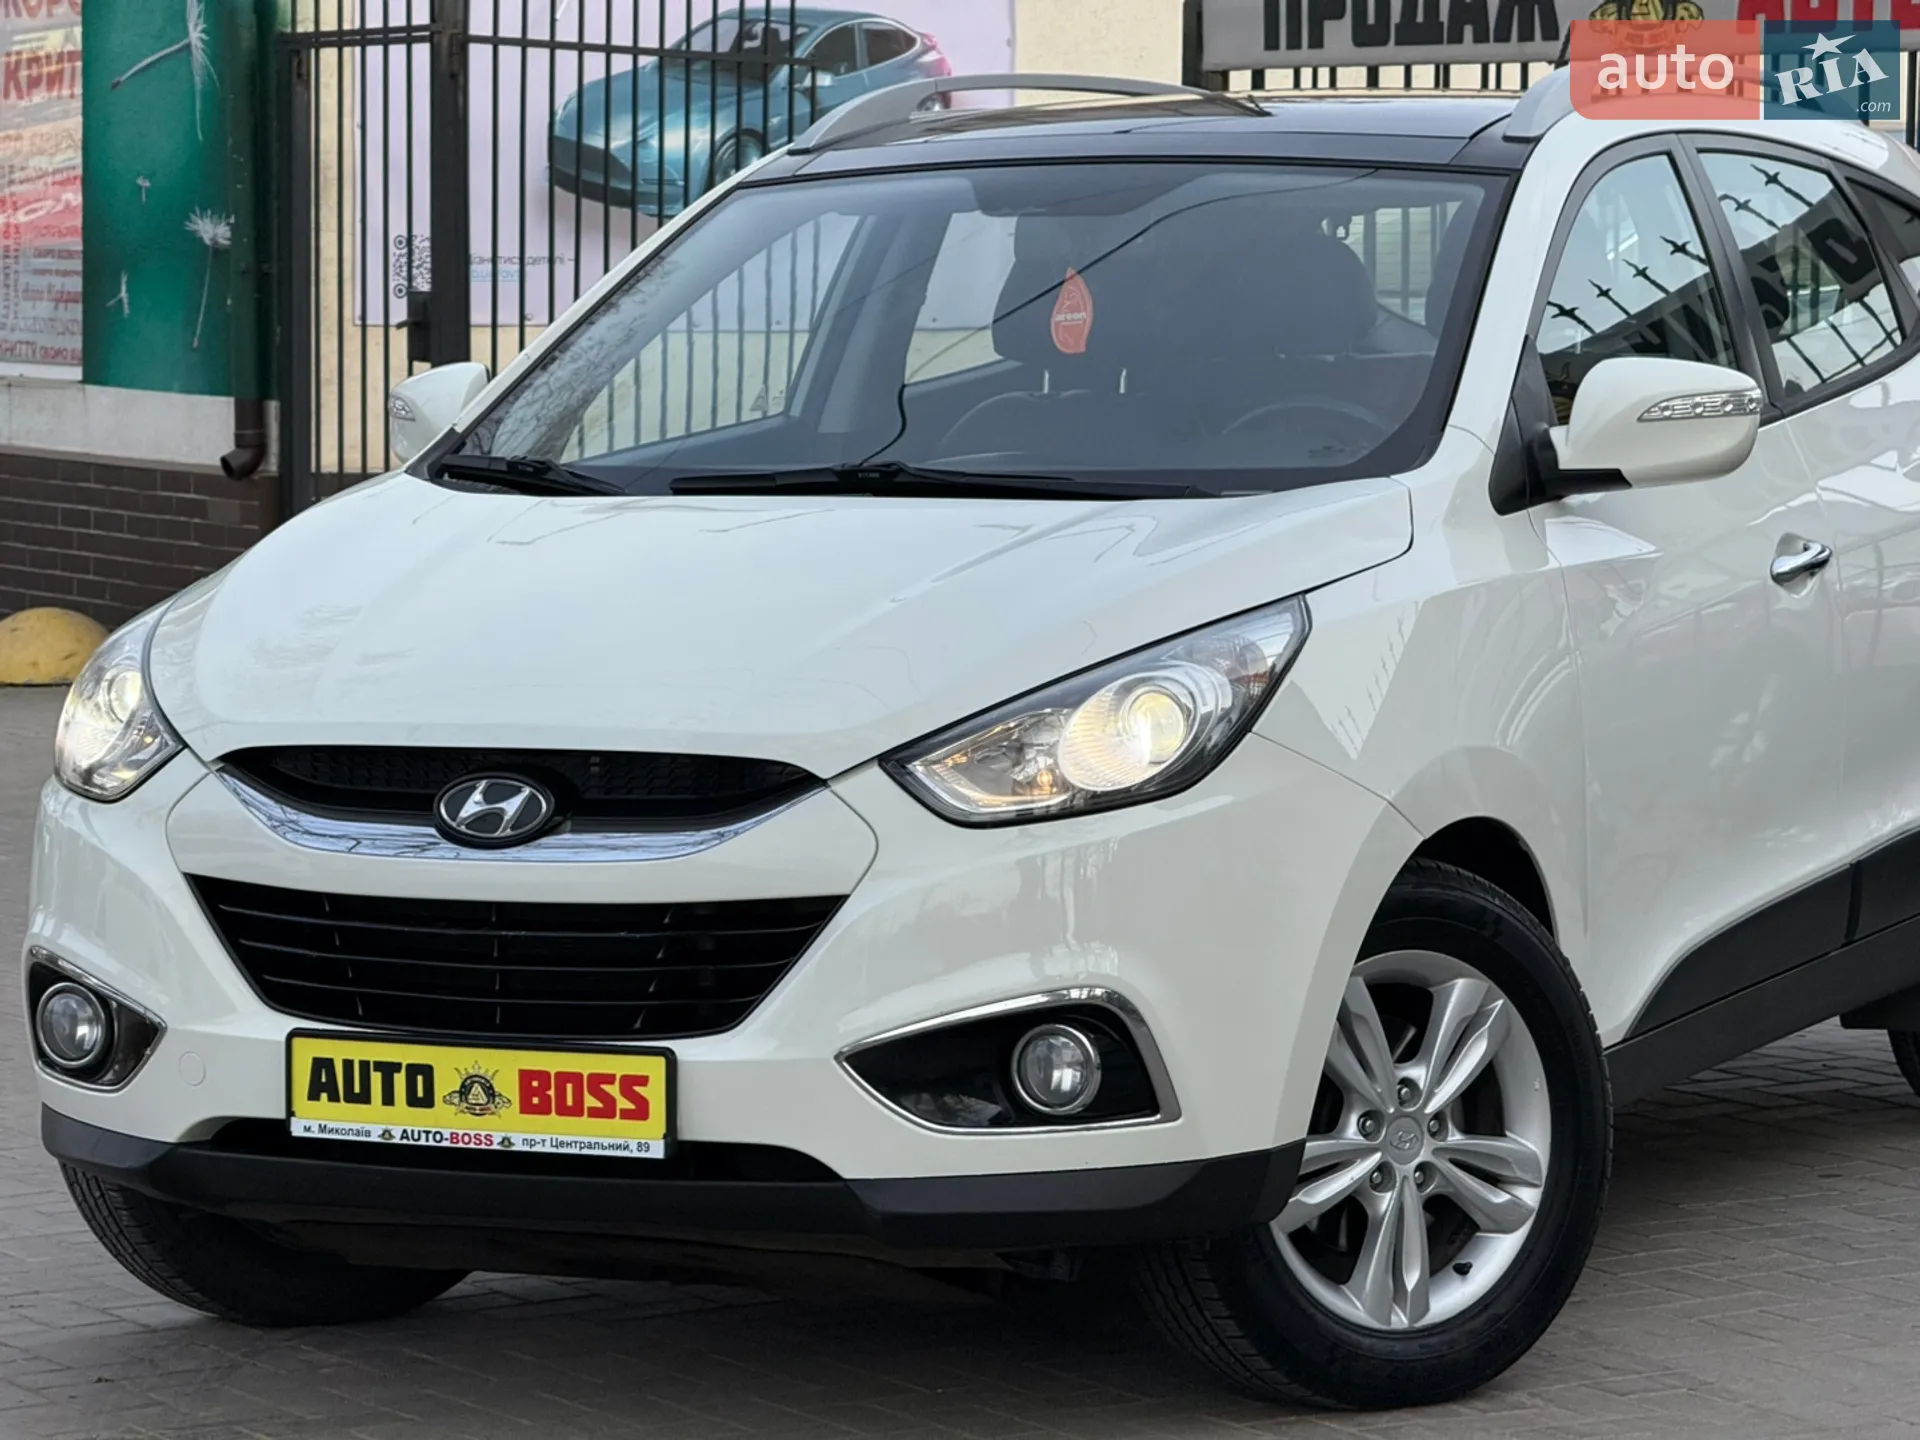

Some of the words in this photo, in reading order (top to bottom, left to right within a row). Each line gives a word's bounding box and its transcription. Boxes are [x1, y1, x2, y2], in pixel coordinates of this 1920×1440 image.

[306, 1056, 436, 1109] AUTO
[518, 1068, 651, 1121] BOSS
[303, 1124, 315, 1133] м.
[318, 1123, 372, 1138] Миколаїв
[399, 1128, 494, 1147] AUTO-BOSS
[522, 1137, 547, 1149] пр-т
[550, 1137, 633, 1154] Центральний,
[636, 1141, 651, 1153] 89
